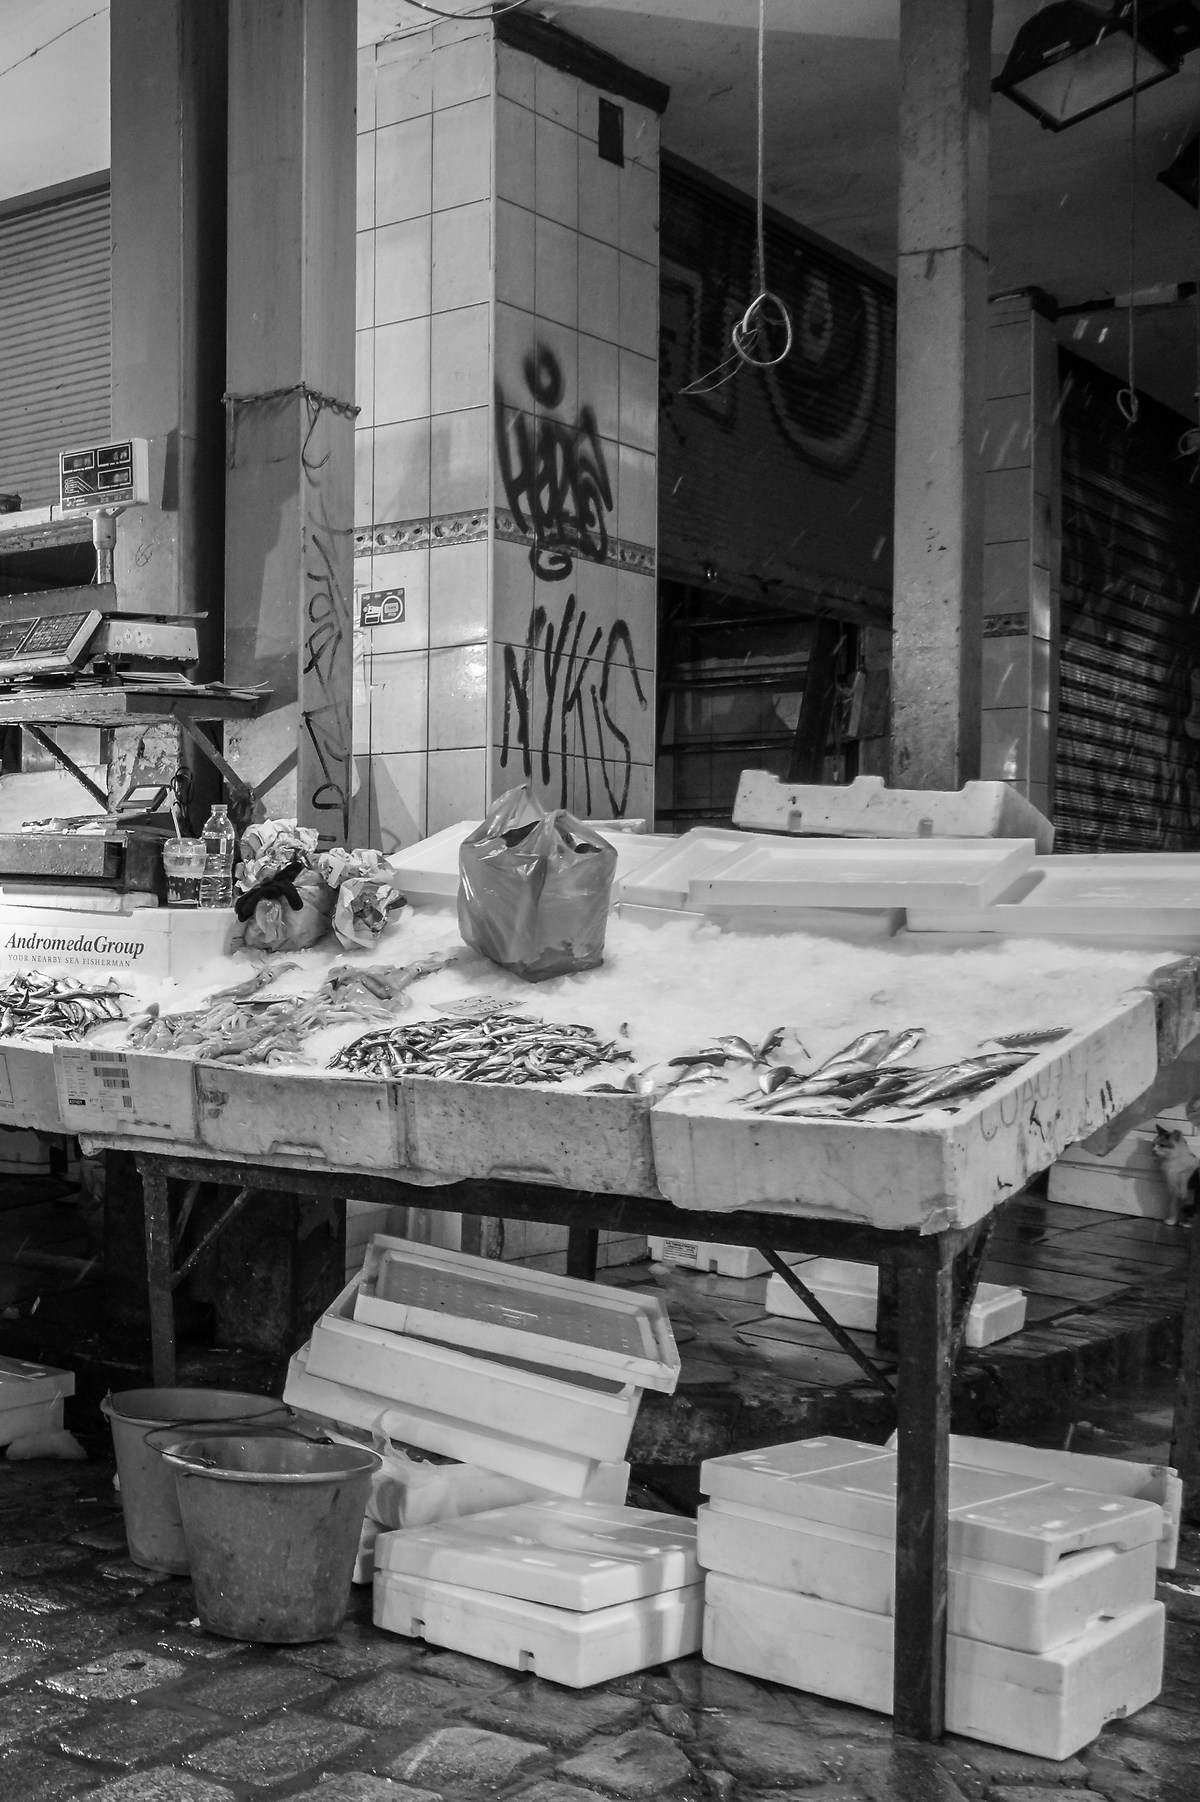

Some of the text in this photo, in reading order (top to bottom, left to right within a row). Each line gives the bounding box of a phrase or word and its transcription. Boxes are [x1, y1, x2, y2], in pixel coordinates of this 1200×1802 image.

[4, 932, 145, 960] AndromedaGroup
[8, 954, 131, 968] YOUR NEARBY SEA FISHERMAN
